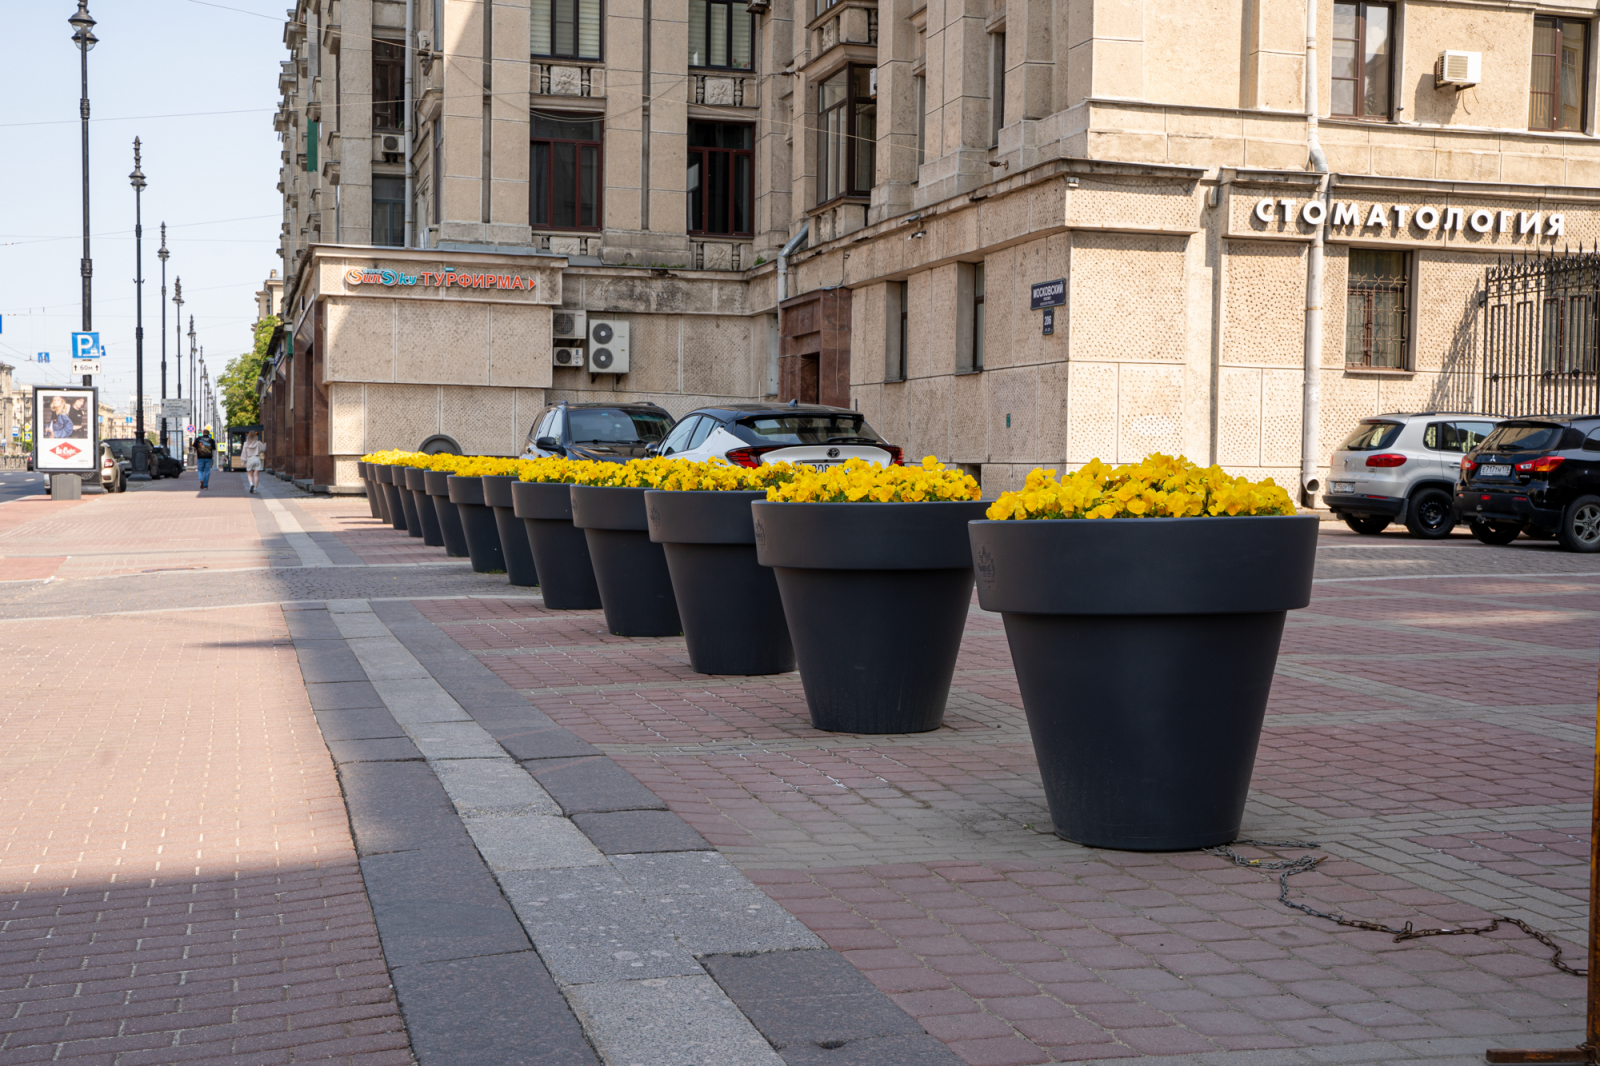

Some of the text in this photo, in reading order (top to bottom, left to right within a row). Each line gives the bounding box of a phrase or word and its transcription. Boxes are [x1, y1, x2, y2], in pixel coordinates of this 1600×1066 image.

[1256, 199, 1566, 236] СТОМАТОЛОГИЯ
[421, 272, 524, 289] ТУРФИРМА
[1032, 281, 1063, 298] МОСКОВСКИЙ
[77, 334, 93, 356] P
